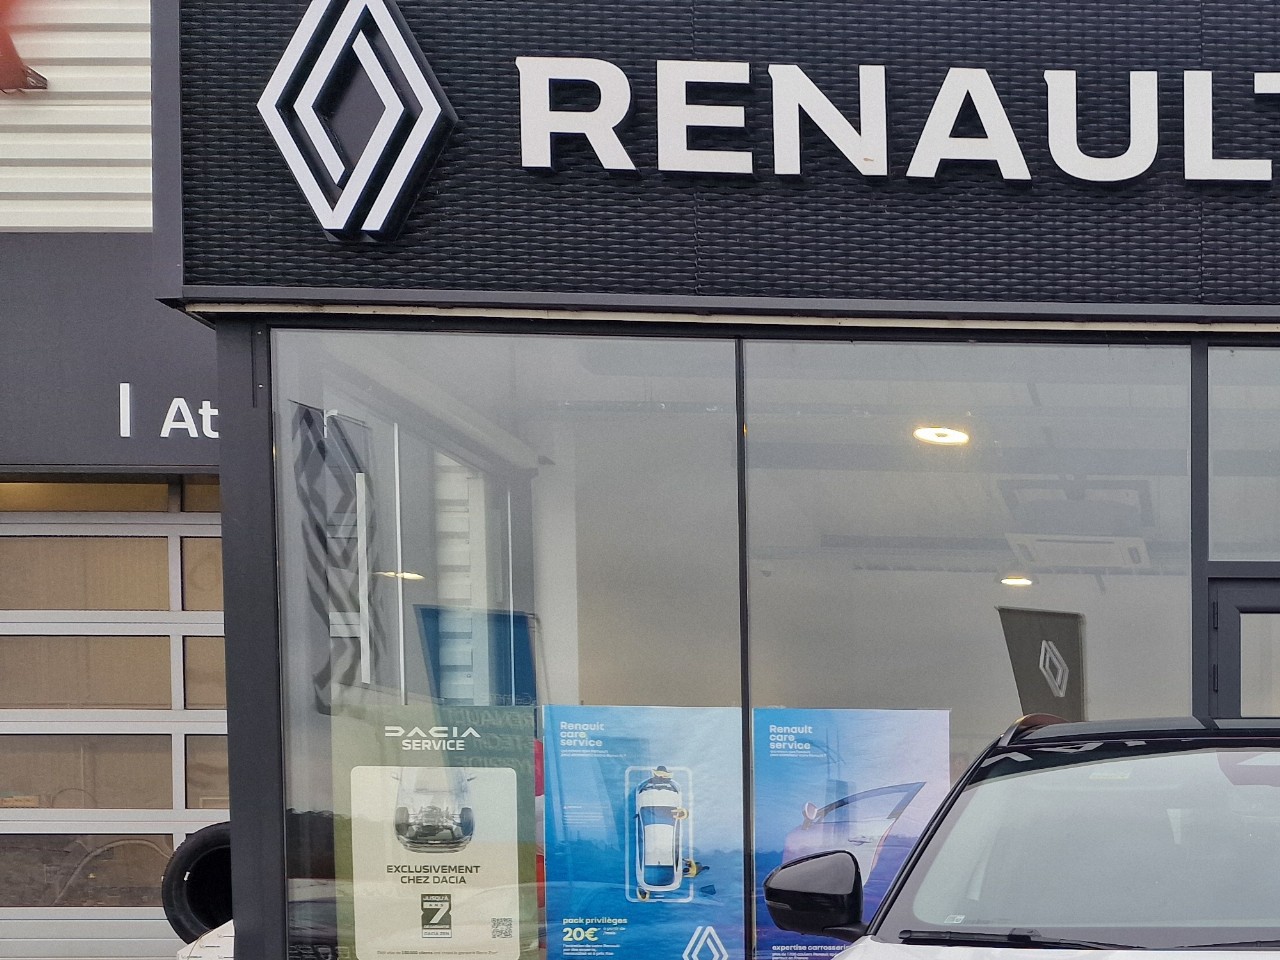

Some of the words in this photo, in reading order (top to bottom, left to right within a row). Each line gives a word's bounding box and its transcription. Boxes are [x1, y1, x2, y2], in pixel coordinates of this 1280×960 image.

[159, 397, 220, 439] At
[560, 721, 605, 731] Renault
[769, 725, 813, 734] Renault
[384, 725, 481, 738] DACIA
[560, 731, 587, 739] care
[560, 738, 603, 747] service
[769, 734, 796, 742] care
[402, 739, 465, 751] SERVICE
[769, 741, 811, 750] service
[386, 865, 481, 874] EXCLUSIVEMENT
[400, 876, 430, 884] CHEZ
[432, 876, 467, 884] DACIA
[562, 917, 584, 925] pack
[585, 917, 628, 925] privilèges
[562, 927, 599, 942] 20€
[771, 944, 807, 952] expertise
